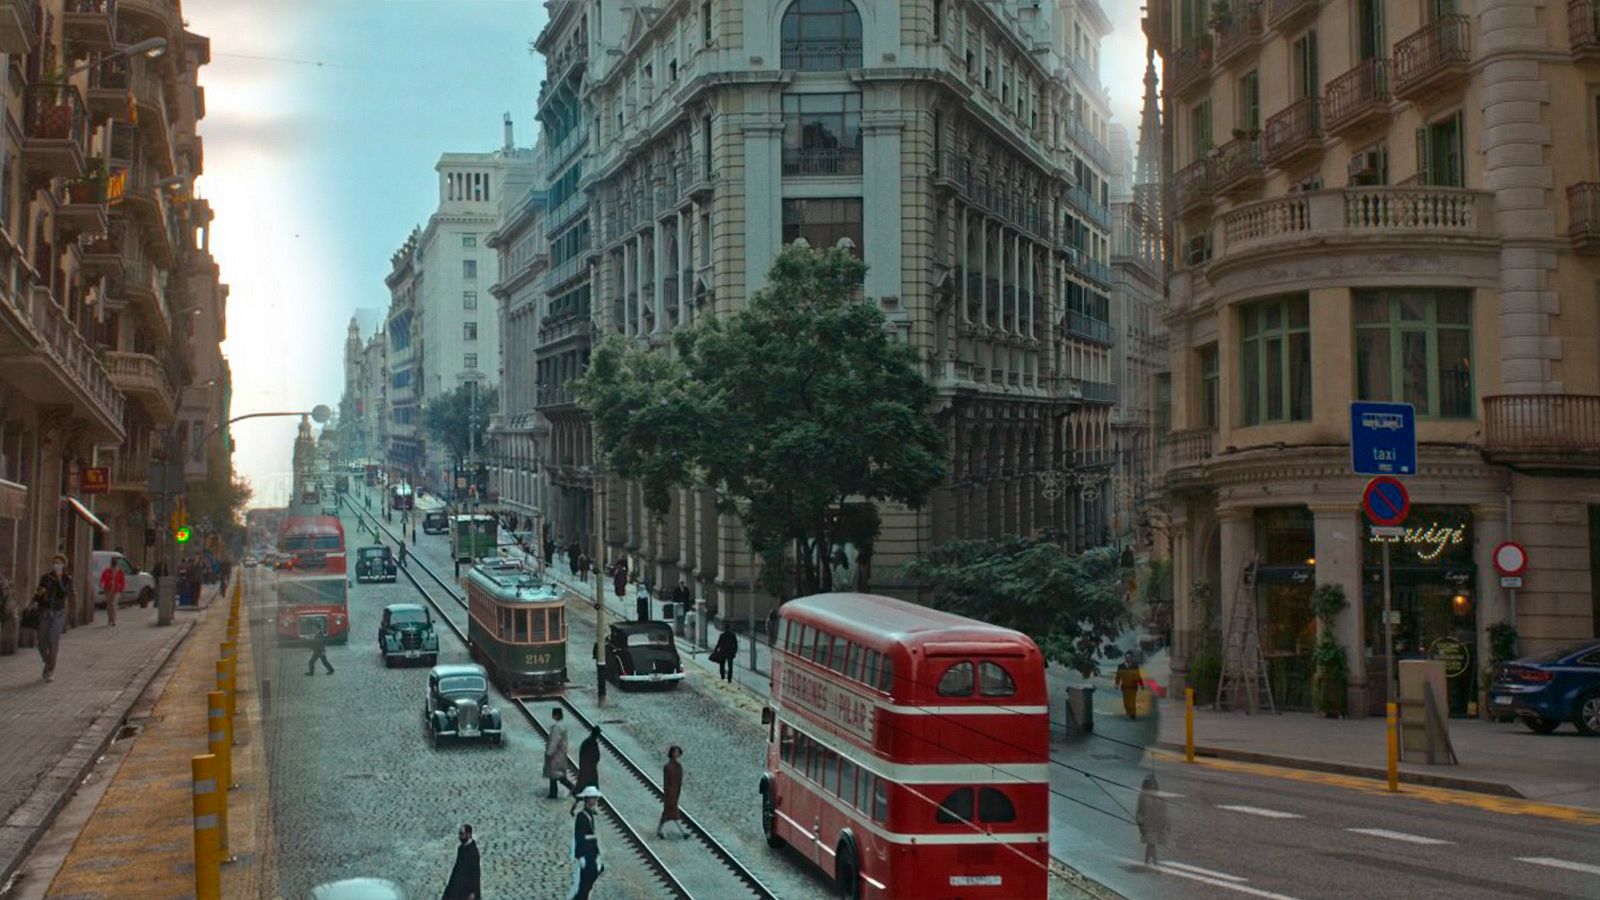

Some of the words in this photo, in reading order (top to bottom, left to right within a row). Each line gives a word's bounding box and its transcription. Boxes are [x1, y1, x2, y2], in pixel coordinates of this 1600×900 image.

[1373, 448, 1397, 461] taxi
[1369, 522, 1466, 560] uigi
[525, 653, 551, 665] 2147
